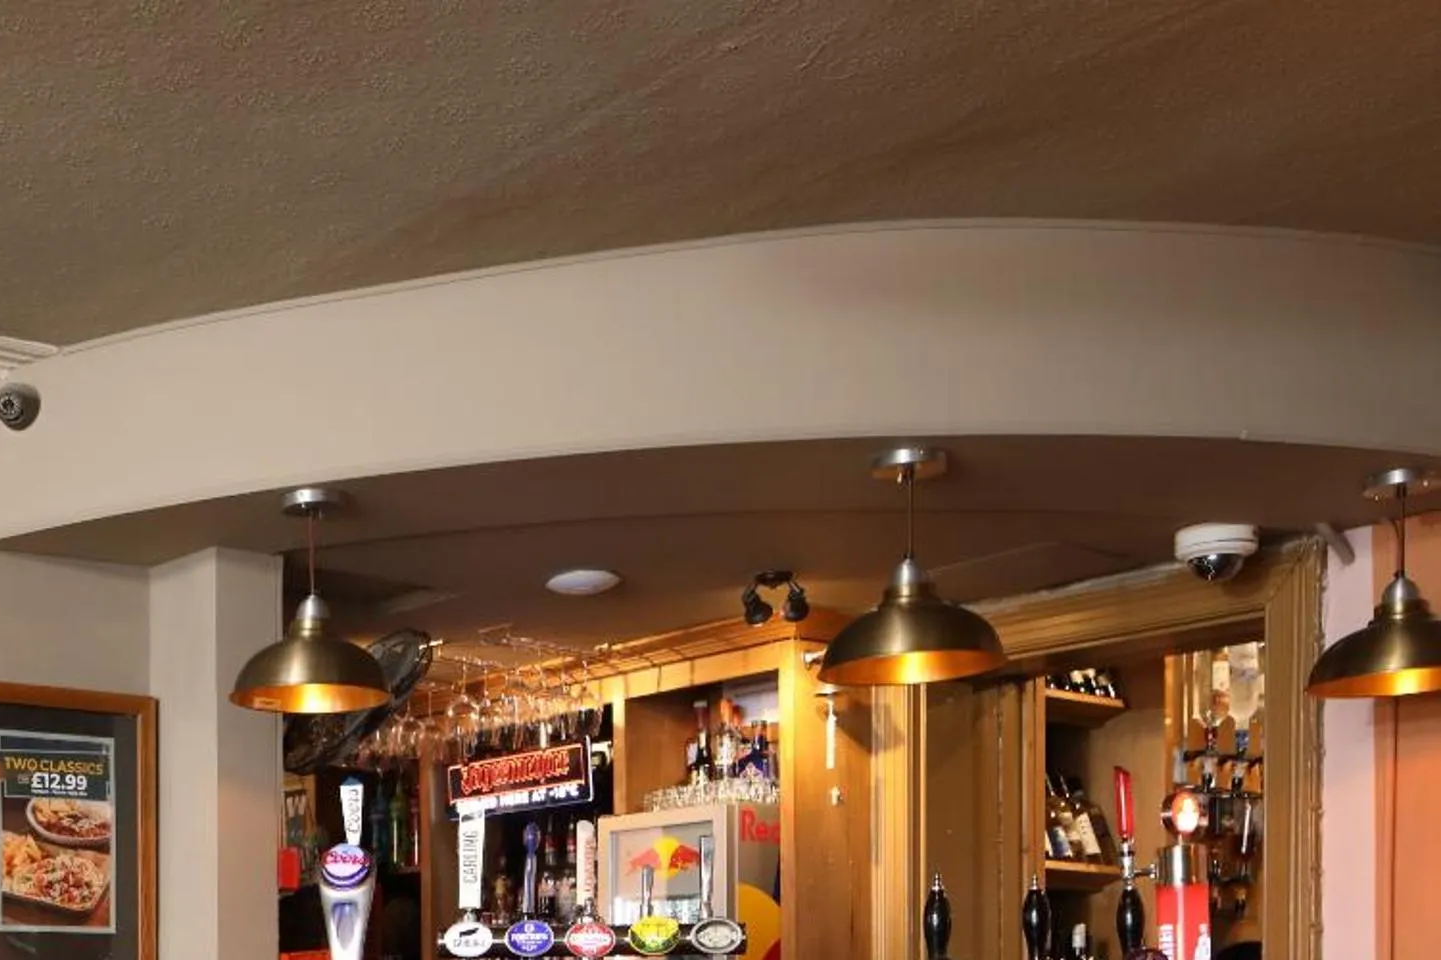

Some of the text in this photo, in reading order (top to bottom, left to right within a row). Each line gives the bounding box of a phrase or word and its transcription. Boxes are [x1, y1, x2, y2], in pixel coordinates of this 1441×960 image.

[4, 756, 104, 775] TWO CLASSICS
[31, 772, 88, 790] £12.99
